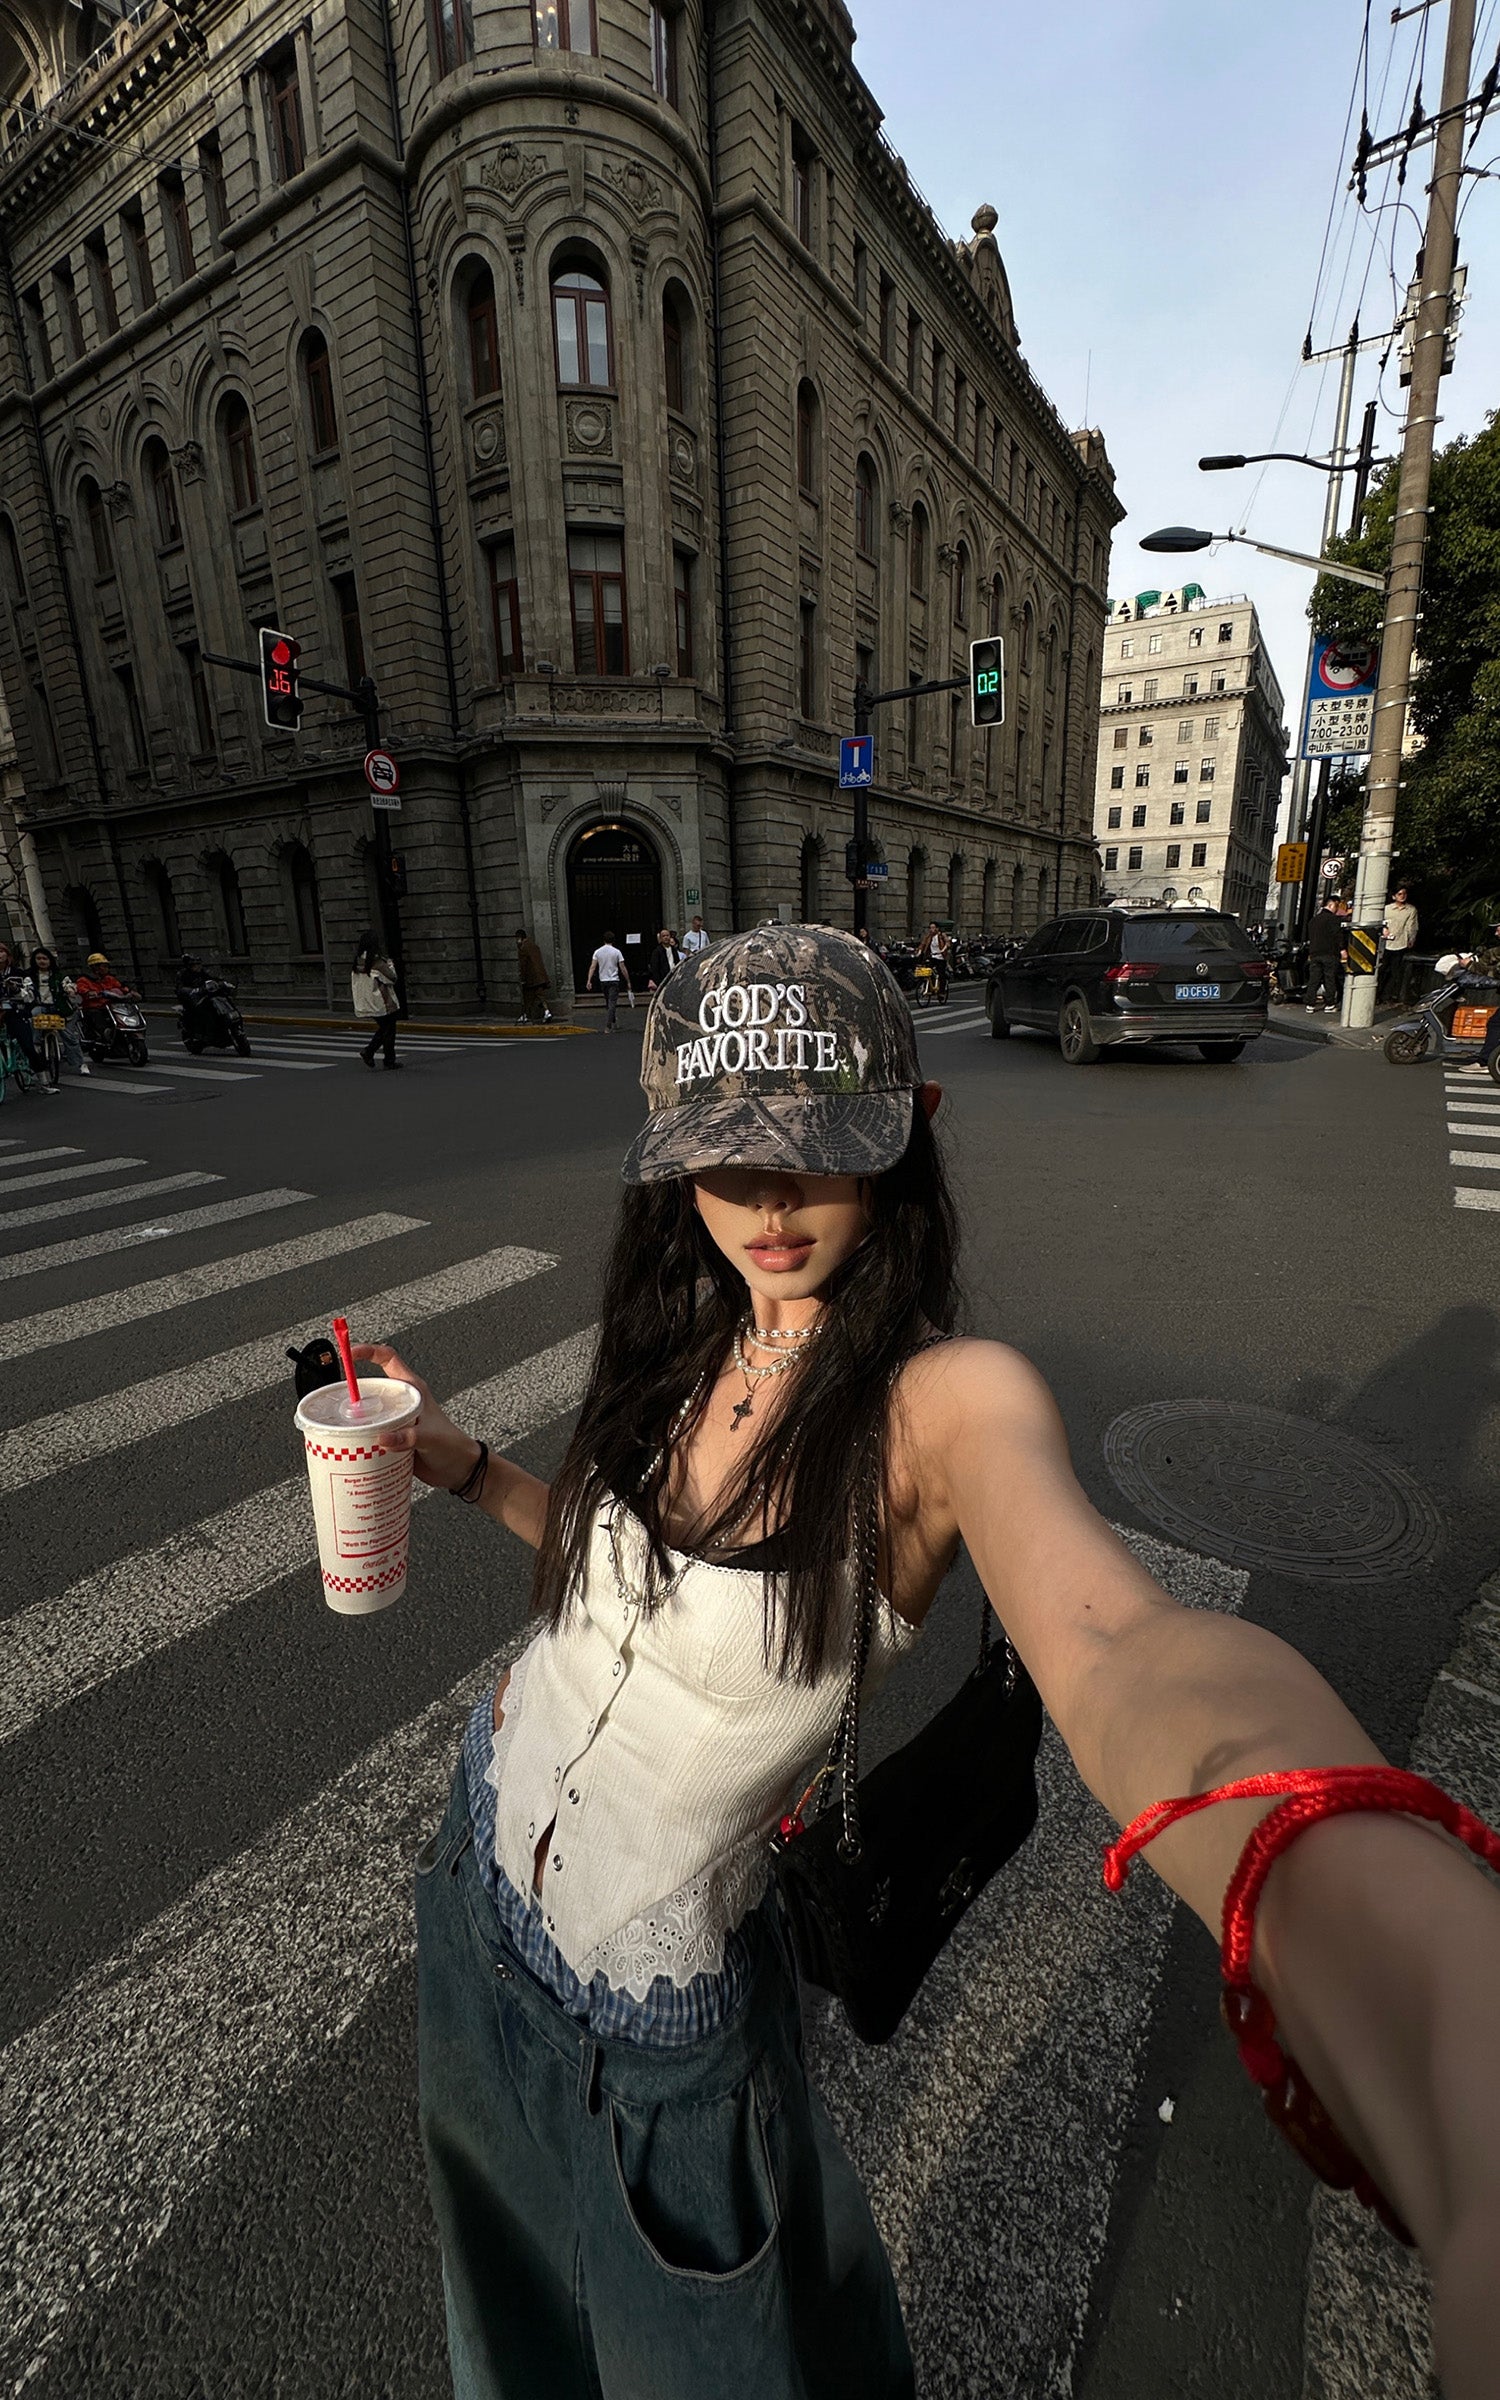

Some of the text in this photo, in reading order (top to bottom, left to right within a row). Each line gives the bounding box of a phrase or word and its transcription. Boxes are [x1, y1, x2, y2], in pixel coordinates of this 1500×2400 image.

[977, 671, 998, 695] 02
[1317, 698, 1368, 713] 大型号牌
[1315, 713, 1366, 728] 小型号牌
[698, 983, 808, 1033] GOD'S
[675, 1029, 840, 1085] FAVORITE
